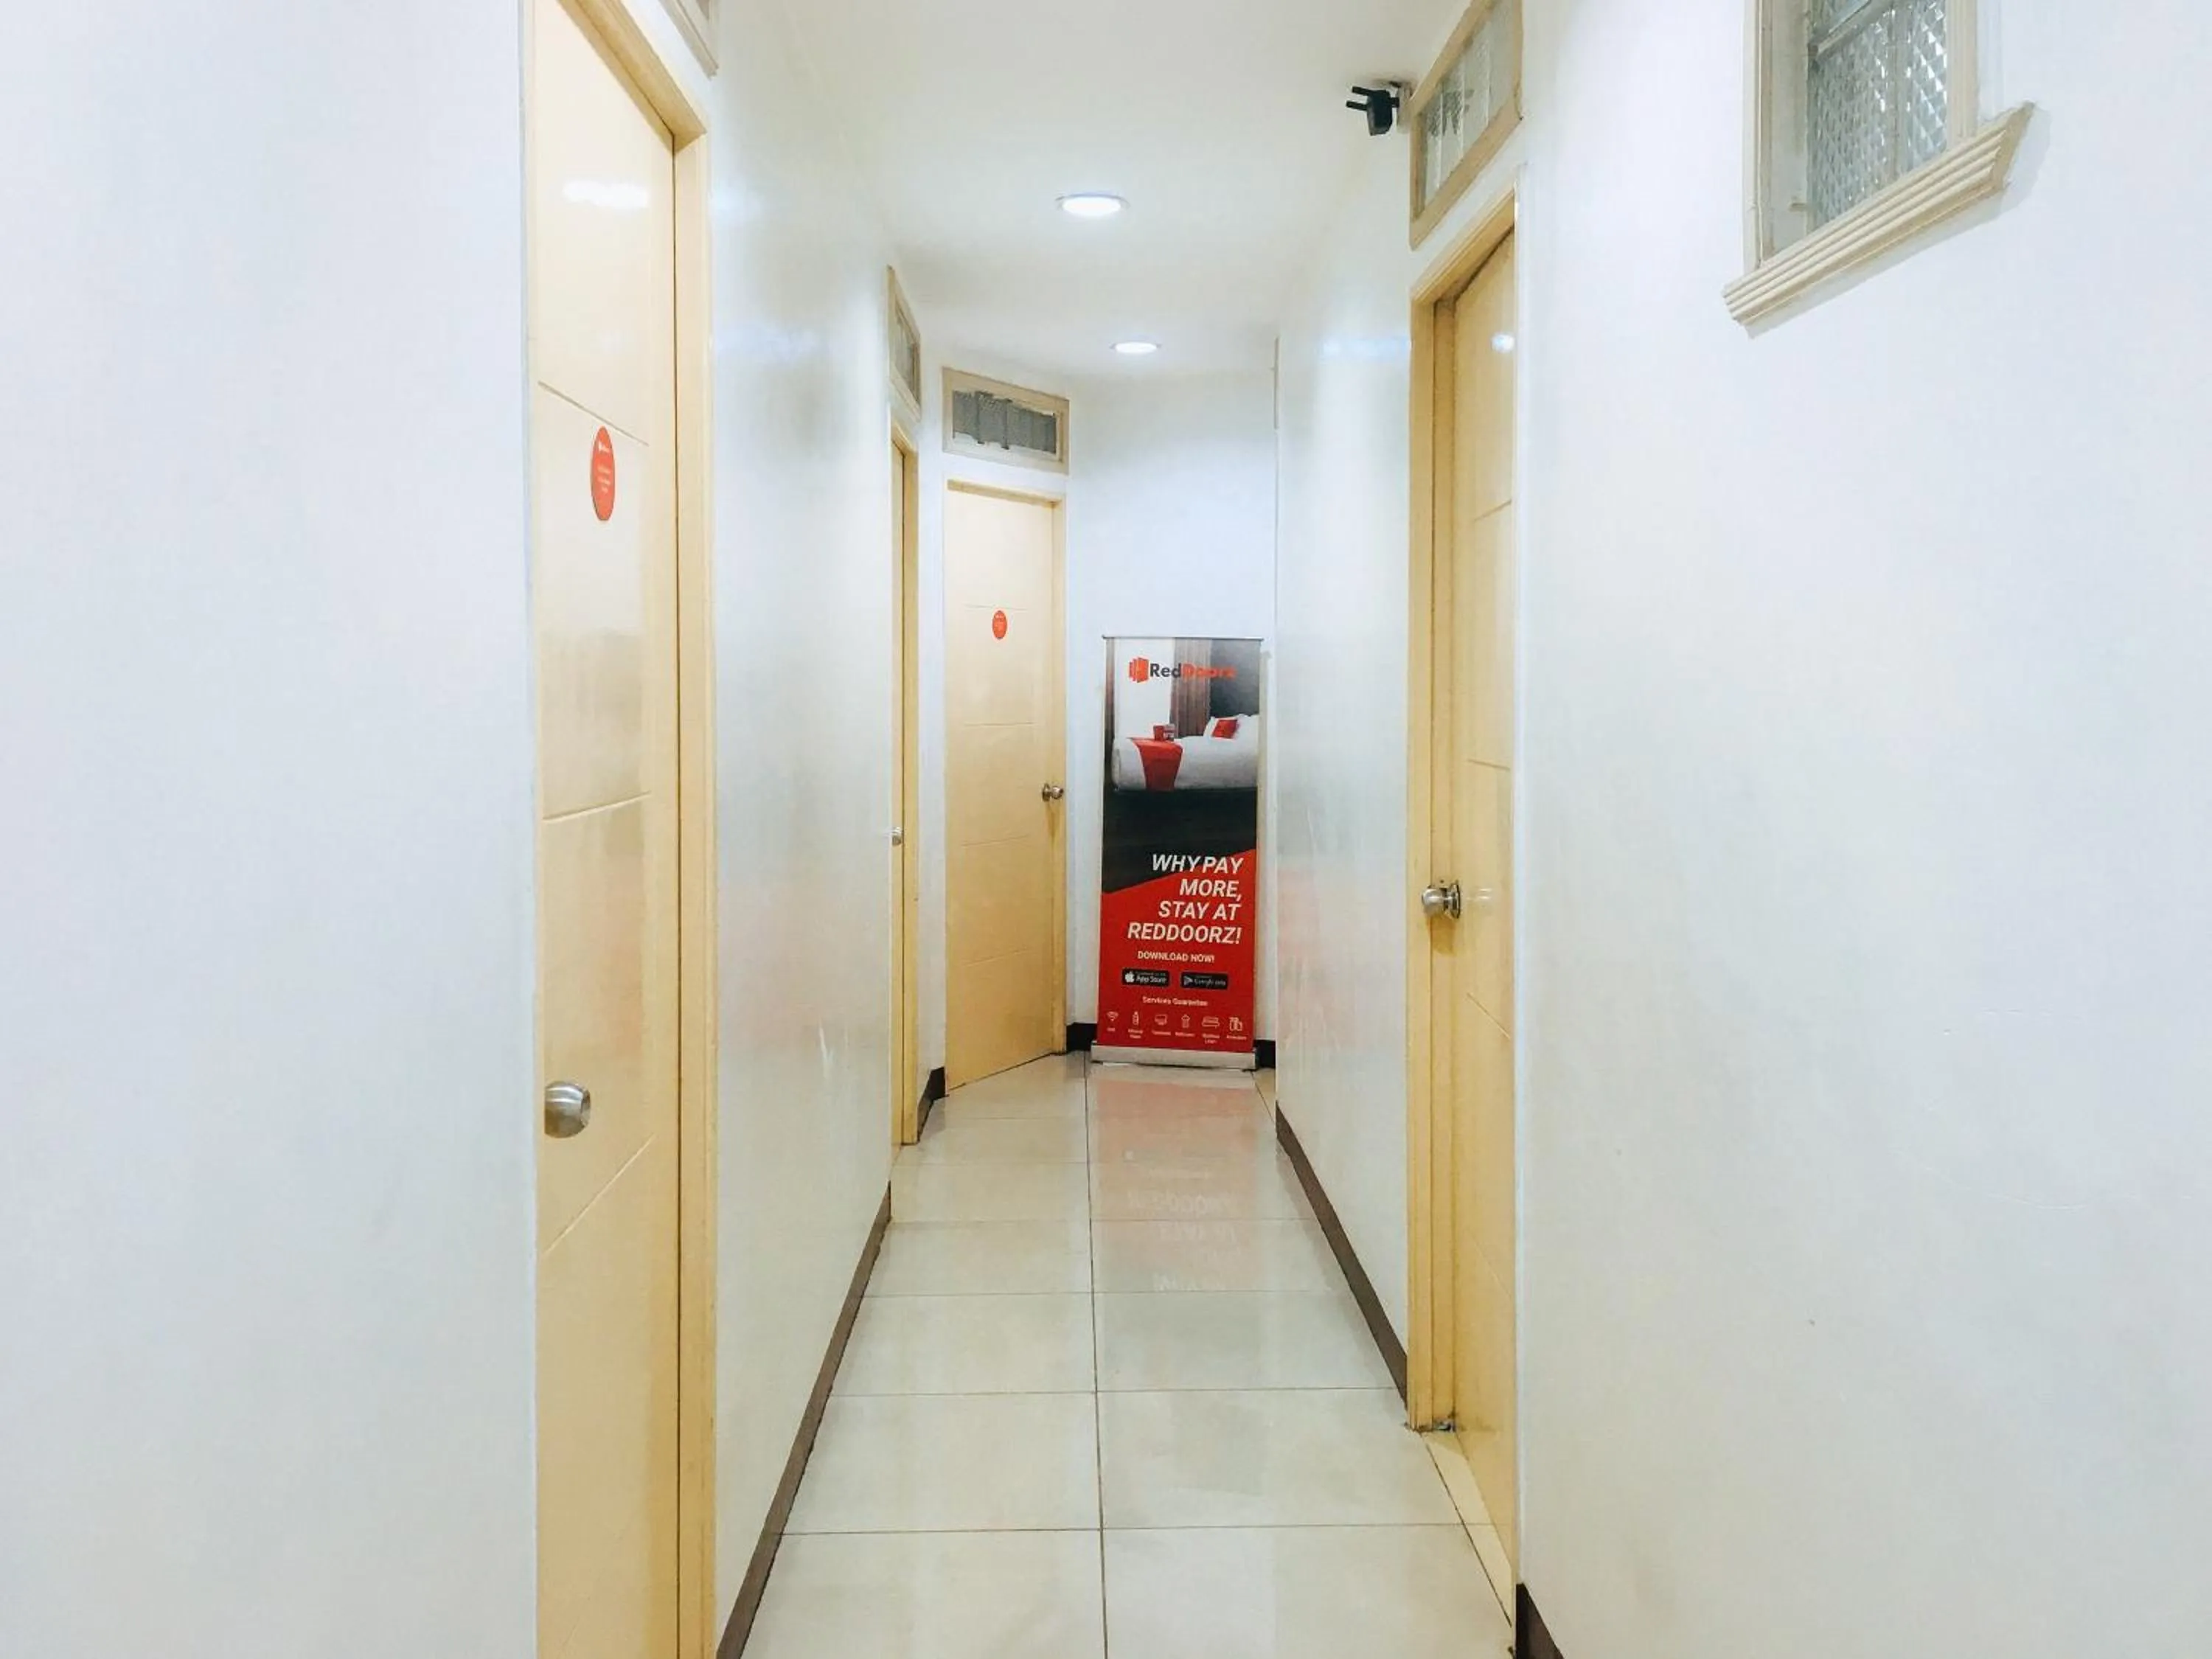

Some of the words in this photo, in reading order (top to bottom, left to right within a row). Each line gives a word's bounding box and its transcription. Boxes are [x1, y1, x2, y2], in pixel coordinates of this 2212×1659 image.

[1152, 853, 1201, 873] WHY
[1202, 856, 1245, 875] PAY
[1179, 877, 1242, 902] MORE,
[1158, 900, 1210, 920] STAY
[1211, 903, 1242, 922] AT
[1127, 921, 1243, 945] REDDOORZ!
[1137, 950, 1189, 962] DOWNLOAD
[1190, 953, 1215, 964] NOW!
